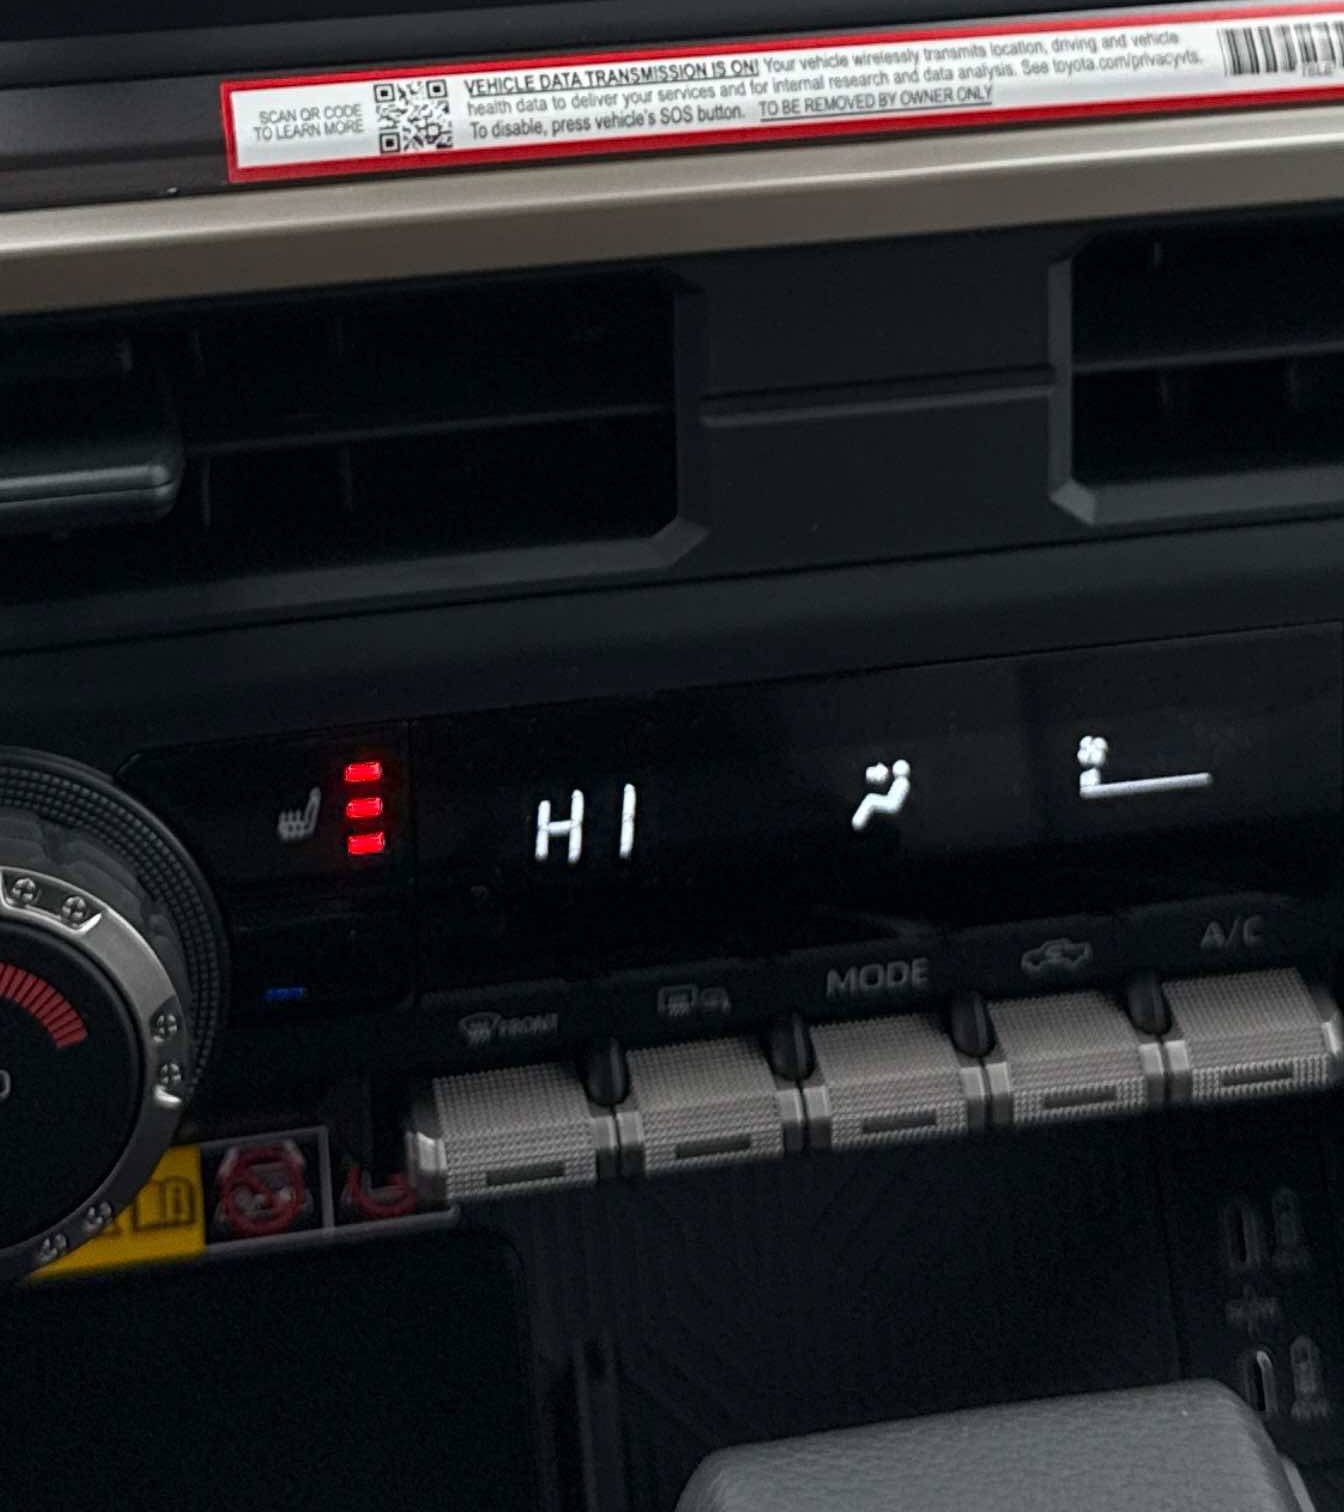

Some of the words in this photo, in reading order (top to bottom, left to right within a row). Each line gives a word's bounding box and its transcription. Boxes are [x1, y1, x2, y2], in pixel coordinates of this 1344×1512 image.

[464, 75, 534, 96] VEHICLE
[540, 70, 582, 90] DATA
[585, 61, 707, 86] TRANSMISSION
[711, 60, 726, 77] IS
[731, 58, 759, 76] ON!
[763, 57, 796, 73] Your
[799, 51, 849, 70] vehicle
[851, 44, 920, 68] wirelessly
[924, 44, 986, 62] transmits
[990, 39, 1047, 58] location,
[1051, 36, 1098, 57] driving
[1102, 34, 1128, 50] and
[1131, 30, 1180, 48] vehicle
[467, 97, 512, 117] health
[517, 94, 548, 113] data
[552, 94, 567, 110] to
[571, 89, 618, 109] deliver
[623, 90, 654, 109] your
[657, 83, 716, 103] services
[720, 80, 746, 98] and
[749, 79, 768, 96] for
[772, 74, 826, 94] internal
[829, 70, 889, 91] research
[894, 69, 919, 86] and
[923, 66, 954, 82] data
[958, 61, 1017, 82] analysis.
[1021, 58, 1050, 75] See
[759, 99, 778, 117] TO
[781, 97, 801, 115] BE
[805, 92, 875, 113] REMOVED
[879, 90, 897, 108] BY
[900, 87, 954, 107] OWNER
[956, 84, 993, 103] ONLY
[254, 125, 274, 142] TO
[276, 120, 322, 139] LEARN
[324, 117, 364, 136] MORE
[259, 109, 297, 125] SCAN
[324, 103, 363, 120] CODE
[470, 120, 488, 138] To
[491, 117, 548, 138] disable,
[552, 115, 591, 136] press
[595, 107, 656, 130] vehicle's
[660, 104, 693, 123] SOS
[697, 102, 746, 124] button.
[535, 784, 637, 862] HI
[1201, 916, 1265, 950] A/C
[826, 958, 929, 997] MODE
